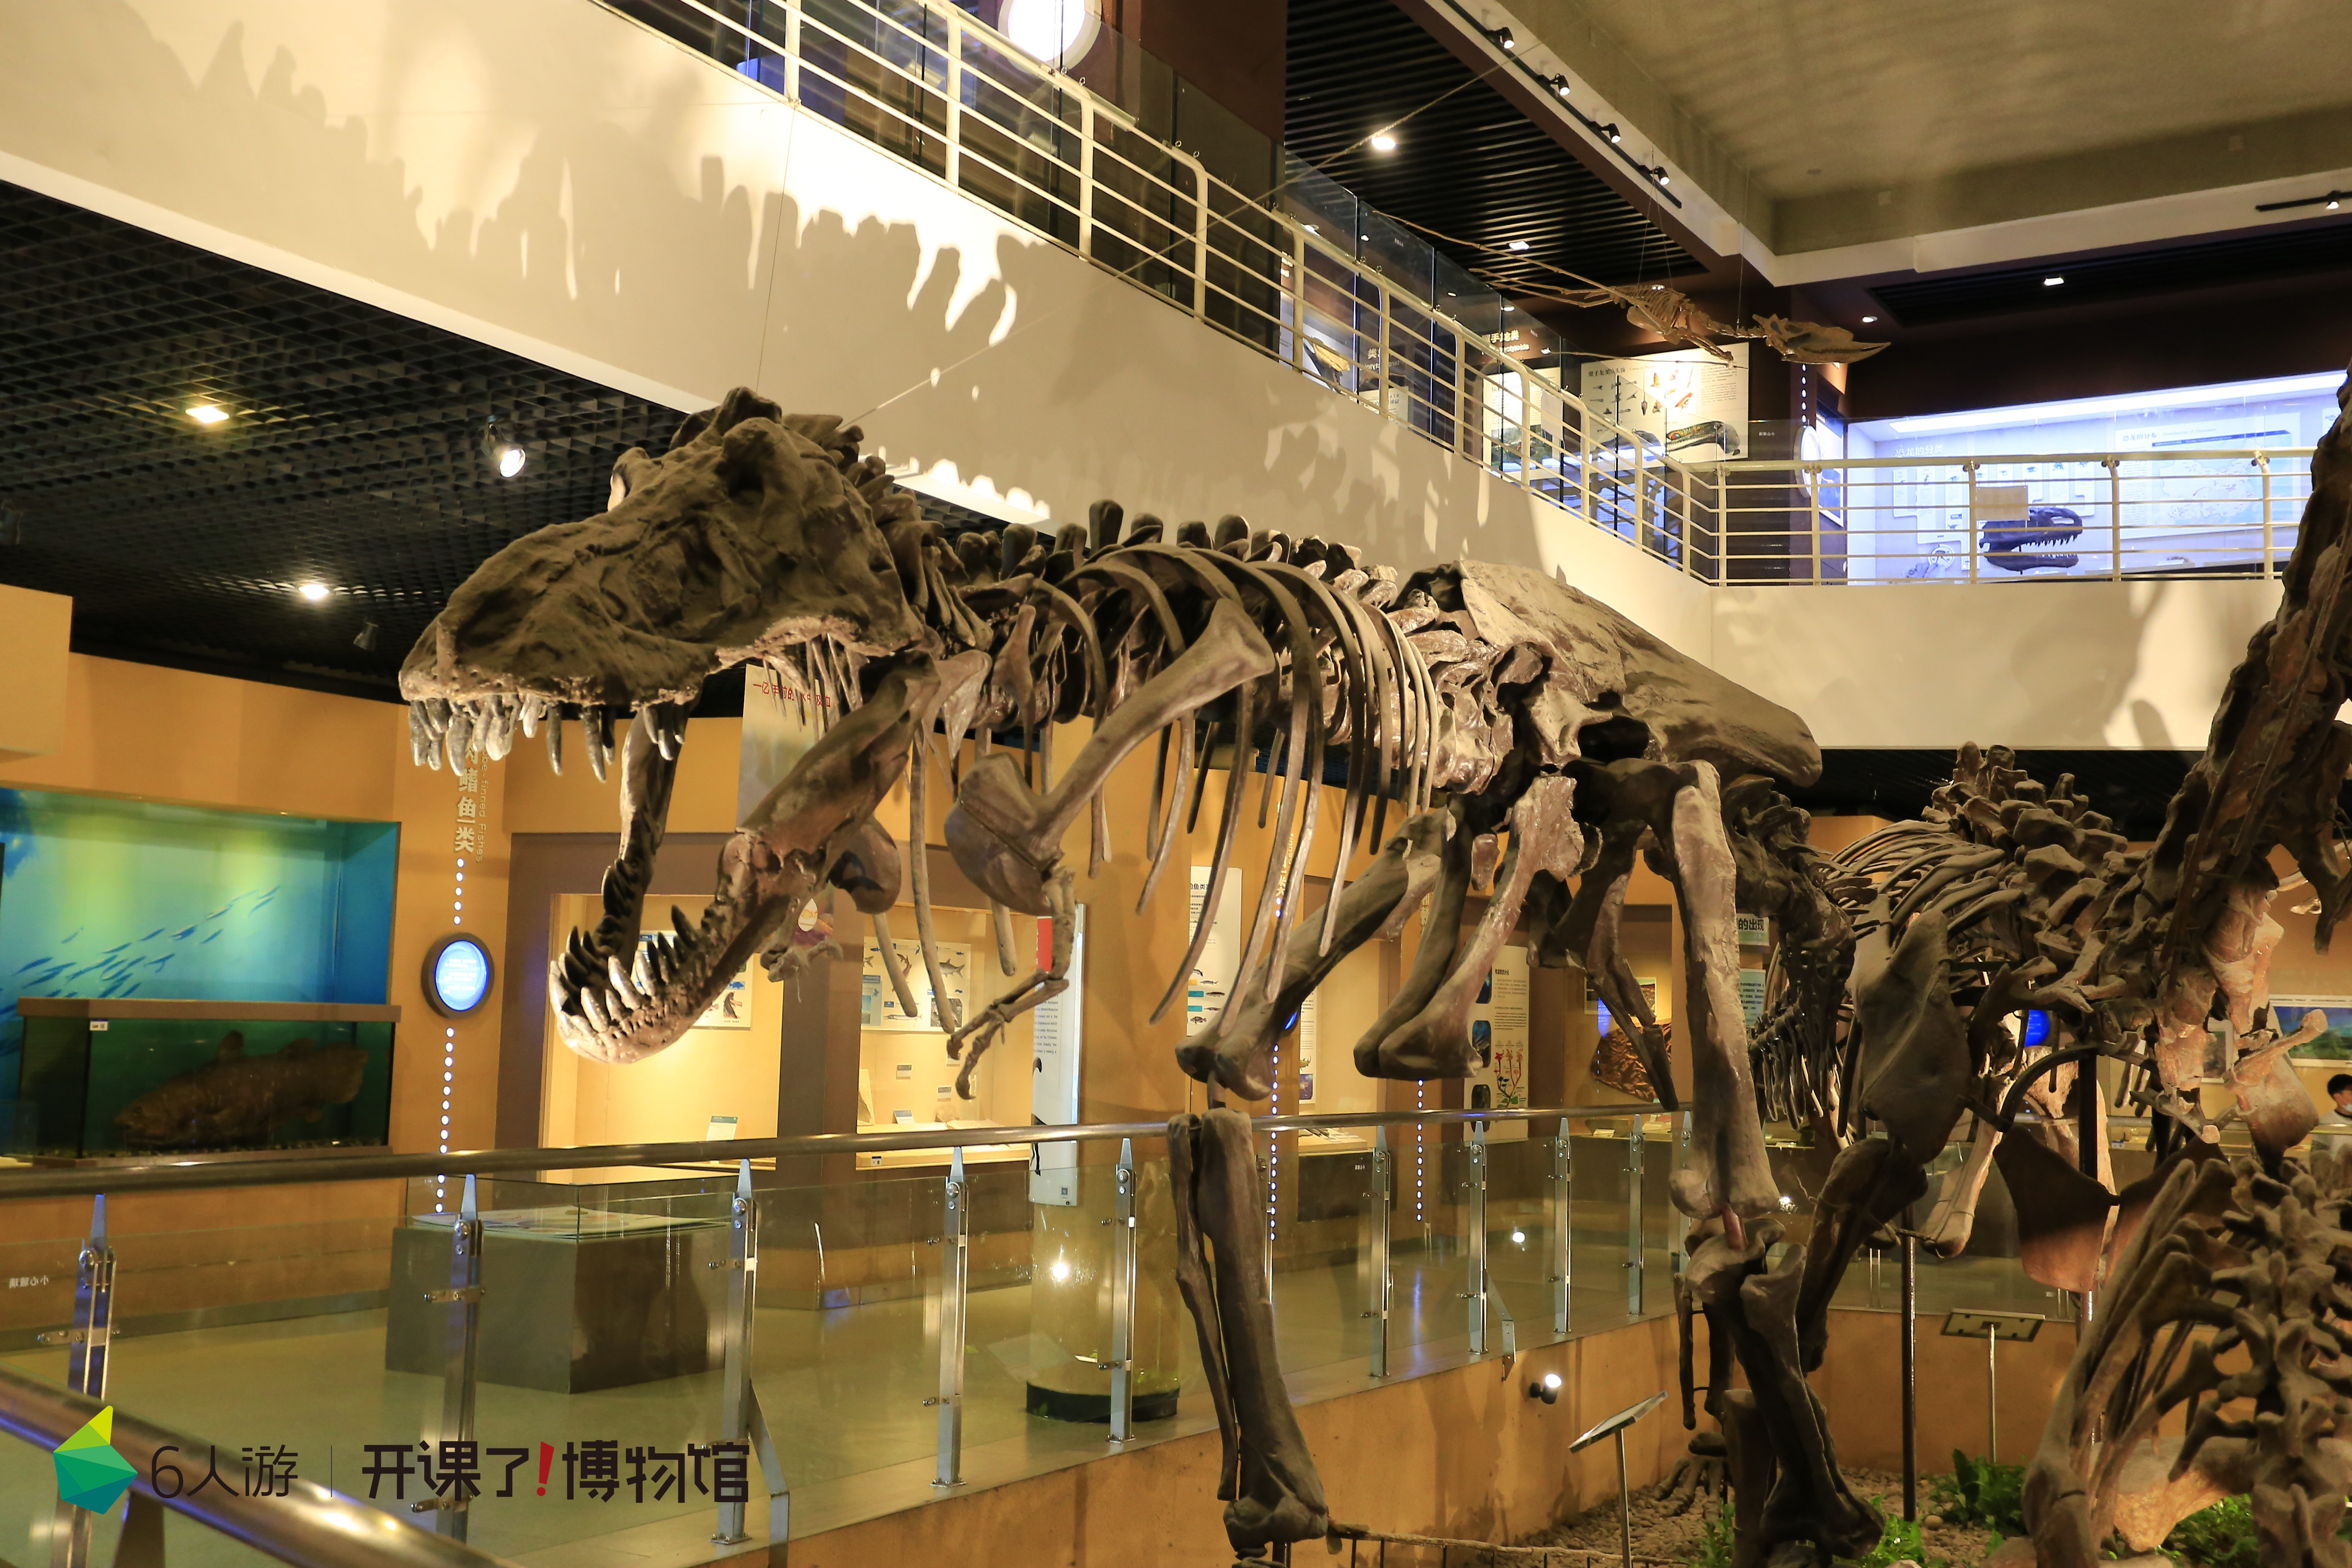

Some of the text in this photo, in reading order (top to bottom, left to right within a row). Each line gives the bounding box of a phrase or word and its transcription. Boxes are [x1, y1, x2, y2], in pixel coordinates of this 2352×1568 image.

[476, 824, 486, 863] Fishes
[1737, 918, 1764, 931] 的出现
